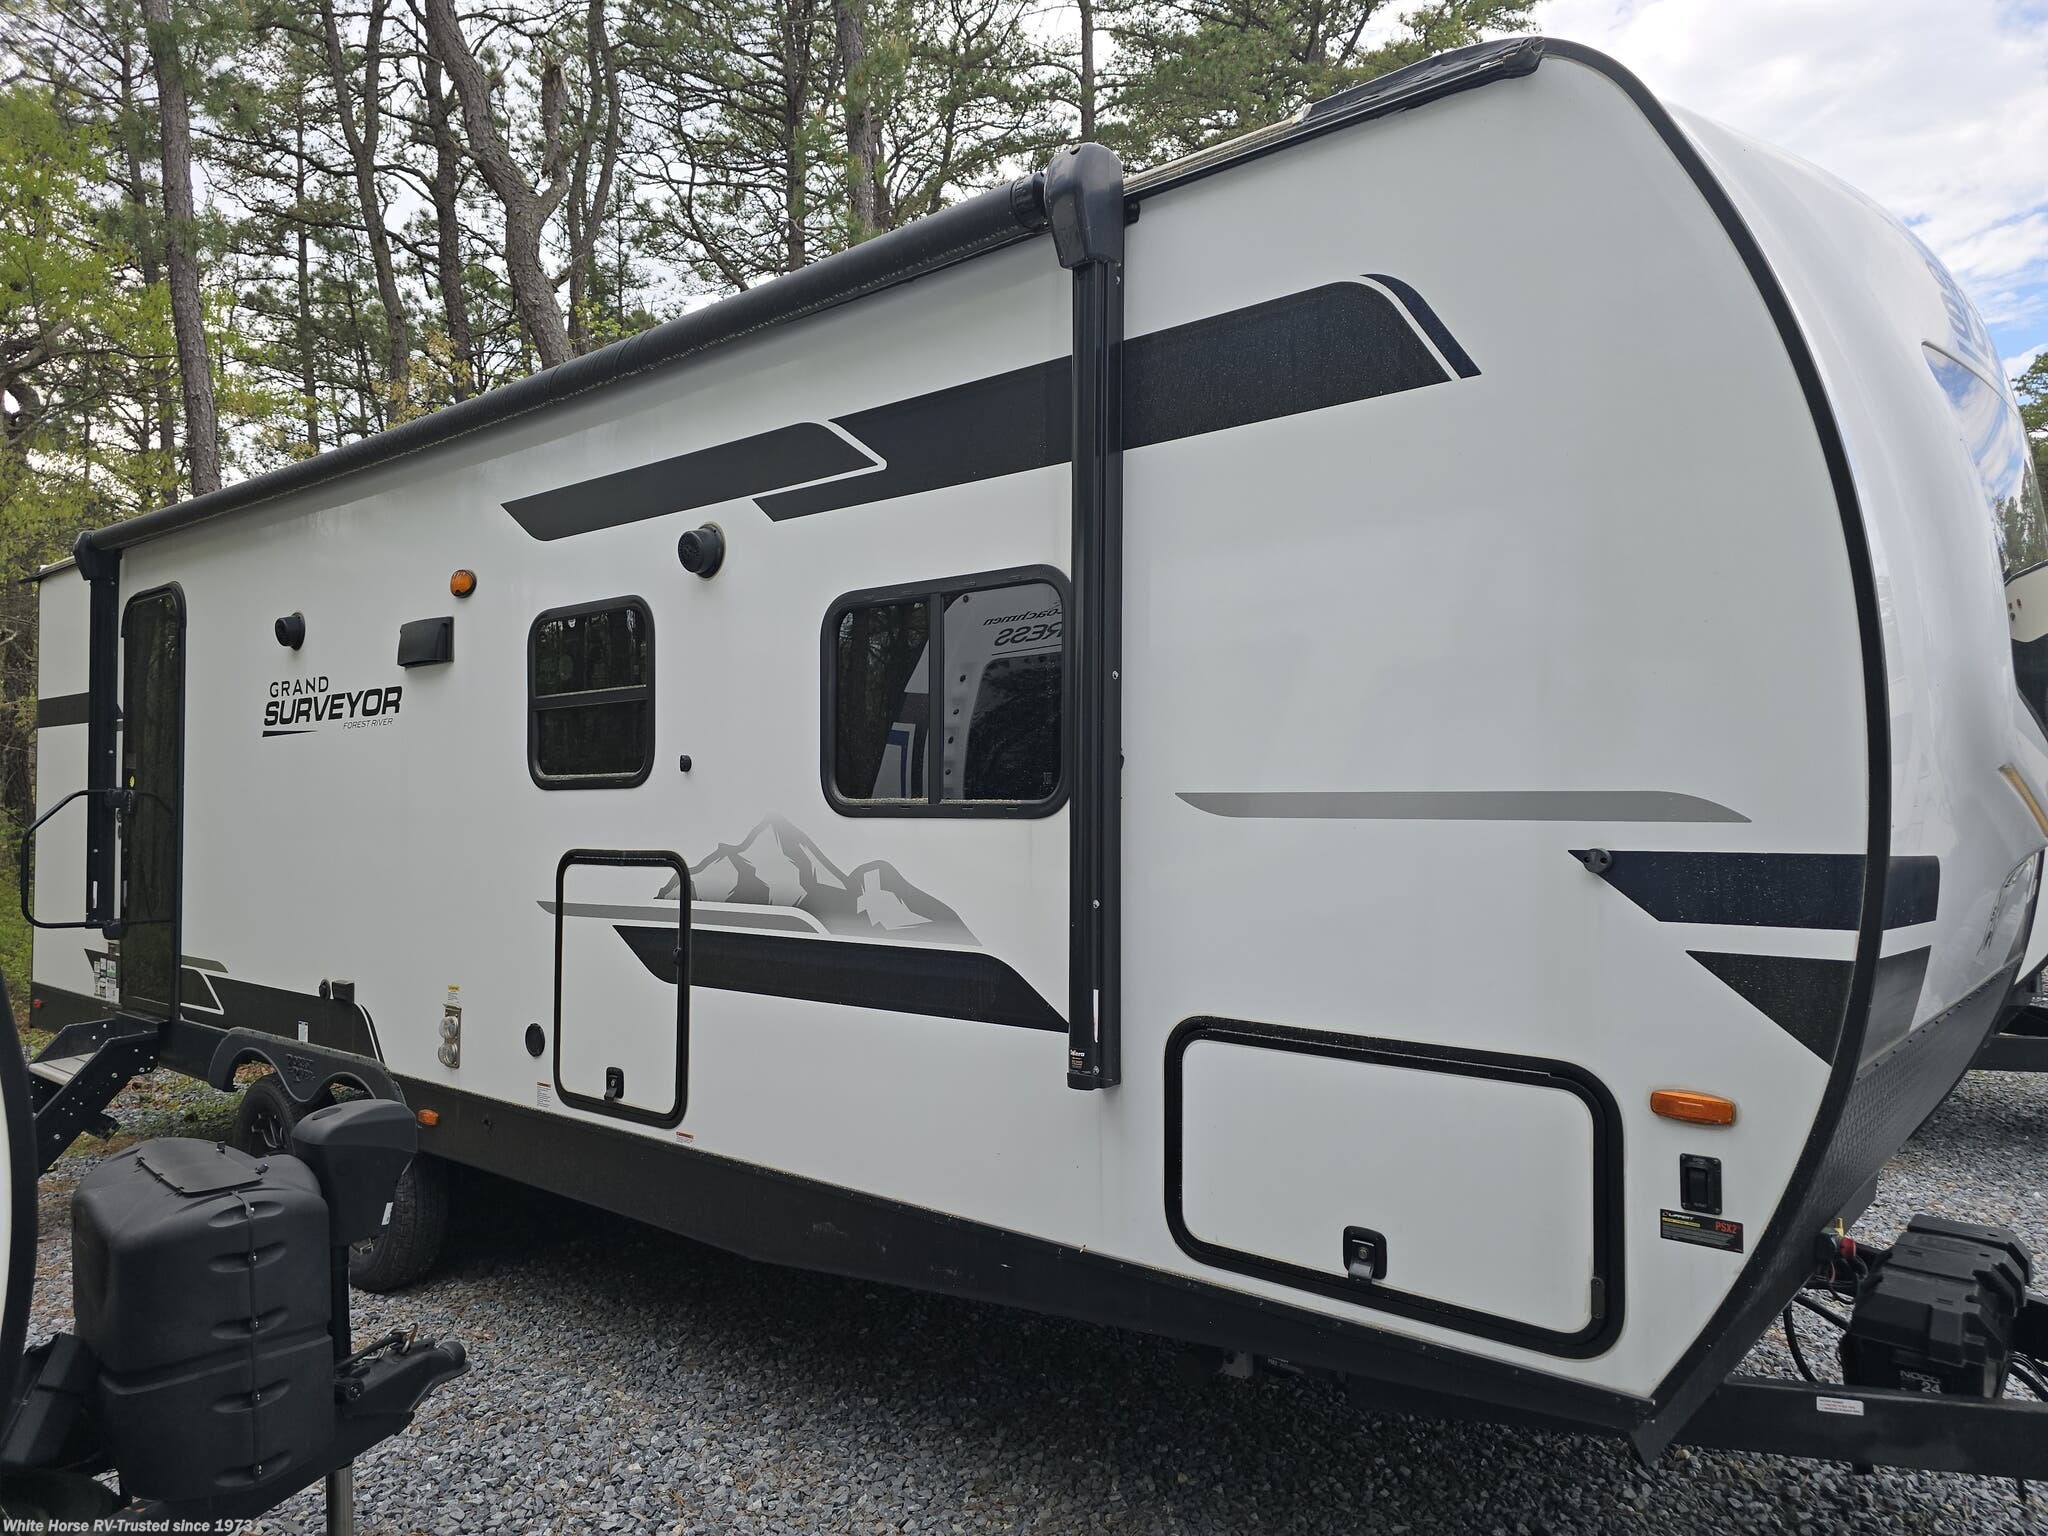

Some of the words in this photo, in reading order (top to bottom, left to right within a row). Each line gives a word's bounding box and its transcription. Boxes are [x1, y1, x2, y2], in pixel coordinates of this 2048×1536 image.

[269, 676, 329, 698] GRAND
[264, 686, 403, 726] SURVEYOR
[343, 719, 370, 730] FOREST
[371, 717, 394, 728] RIVER
[1921, 1381, 1942, 1394] 24
